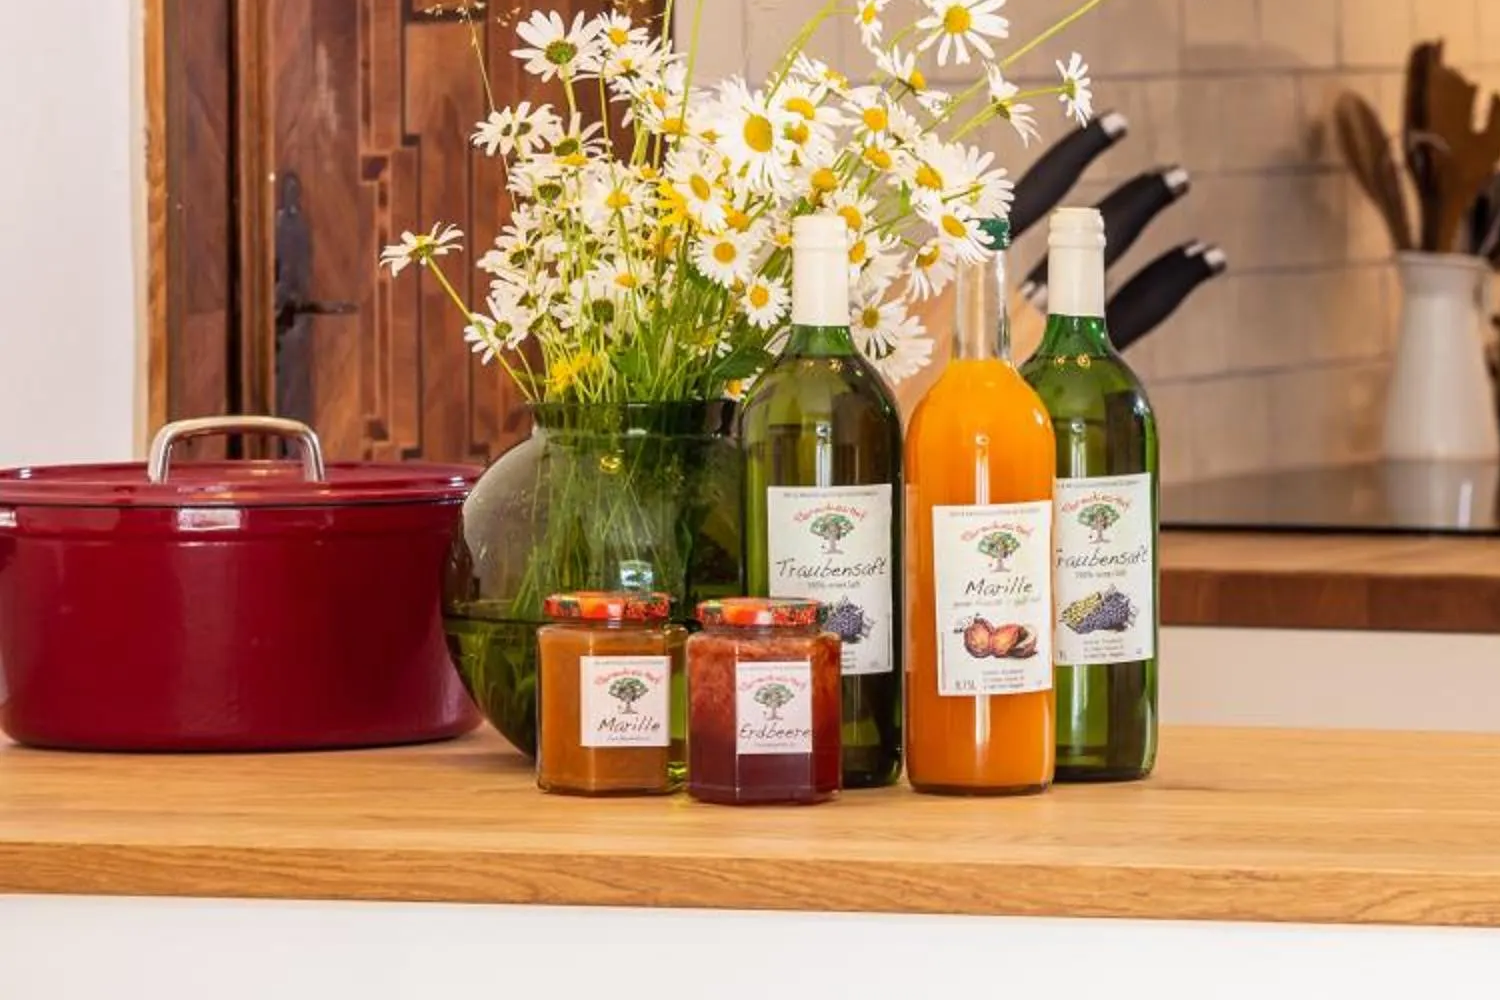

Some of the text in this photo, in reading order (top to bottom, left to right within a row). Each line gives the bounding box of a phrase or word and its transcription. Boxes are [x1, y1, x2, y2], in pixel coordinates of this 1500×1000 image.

[1056, 544, 1149, 570] raubensaft
[776, 557, 887, 580] Traubensaft
[965, 575, 1033, 597] Marille
[597, 715, 660, 732] Marille
[740, 722, 811, 738] Erdbeere
